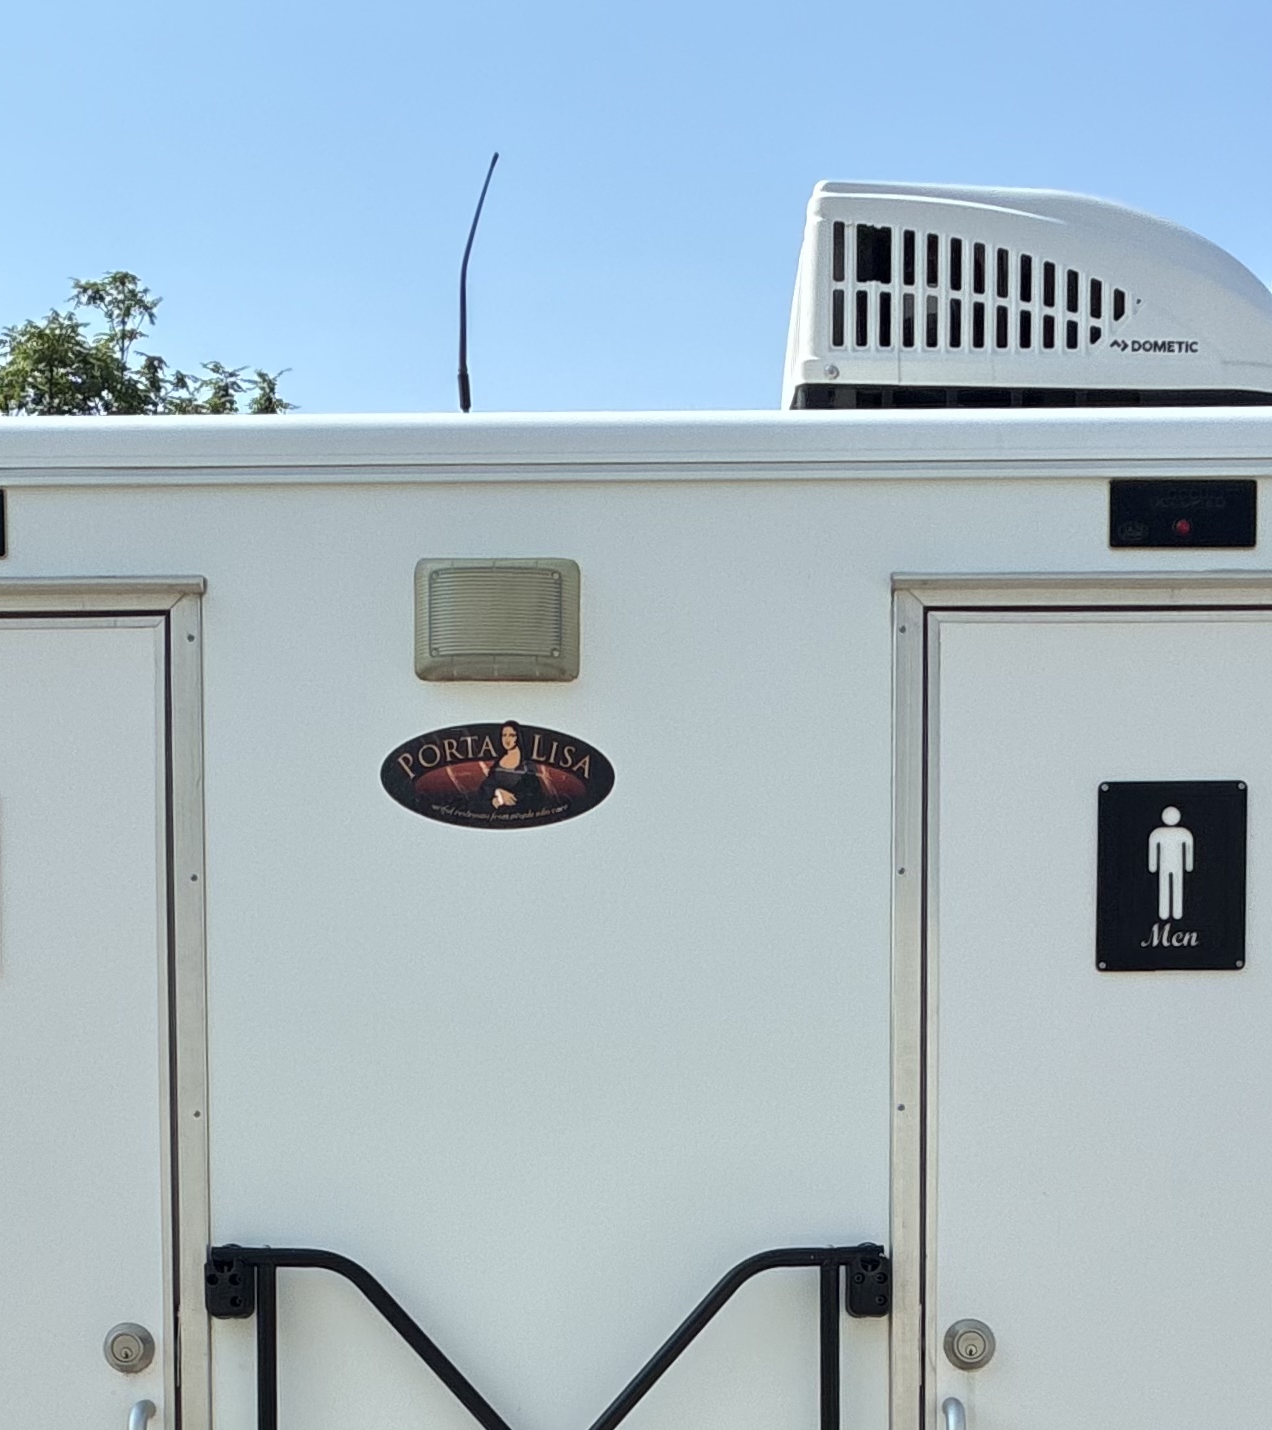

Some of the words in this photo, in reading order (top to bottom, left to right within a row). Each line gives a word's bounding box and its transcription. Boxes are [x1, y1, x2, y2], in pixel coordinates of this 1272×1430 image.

[1131, 340, 1198, 353] DOMETIC
[397, 735, 498, 780] PORTA
[532, 734, 592, 780] LISA
[1140, 923, 1199, 947] Men
